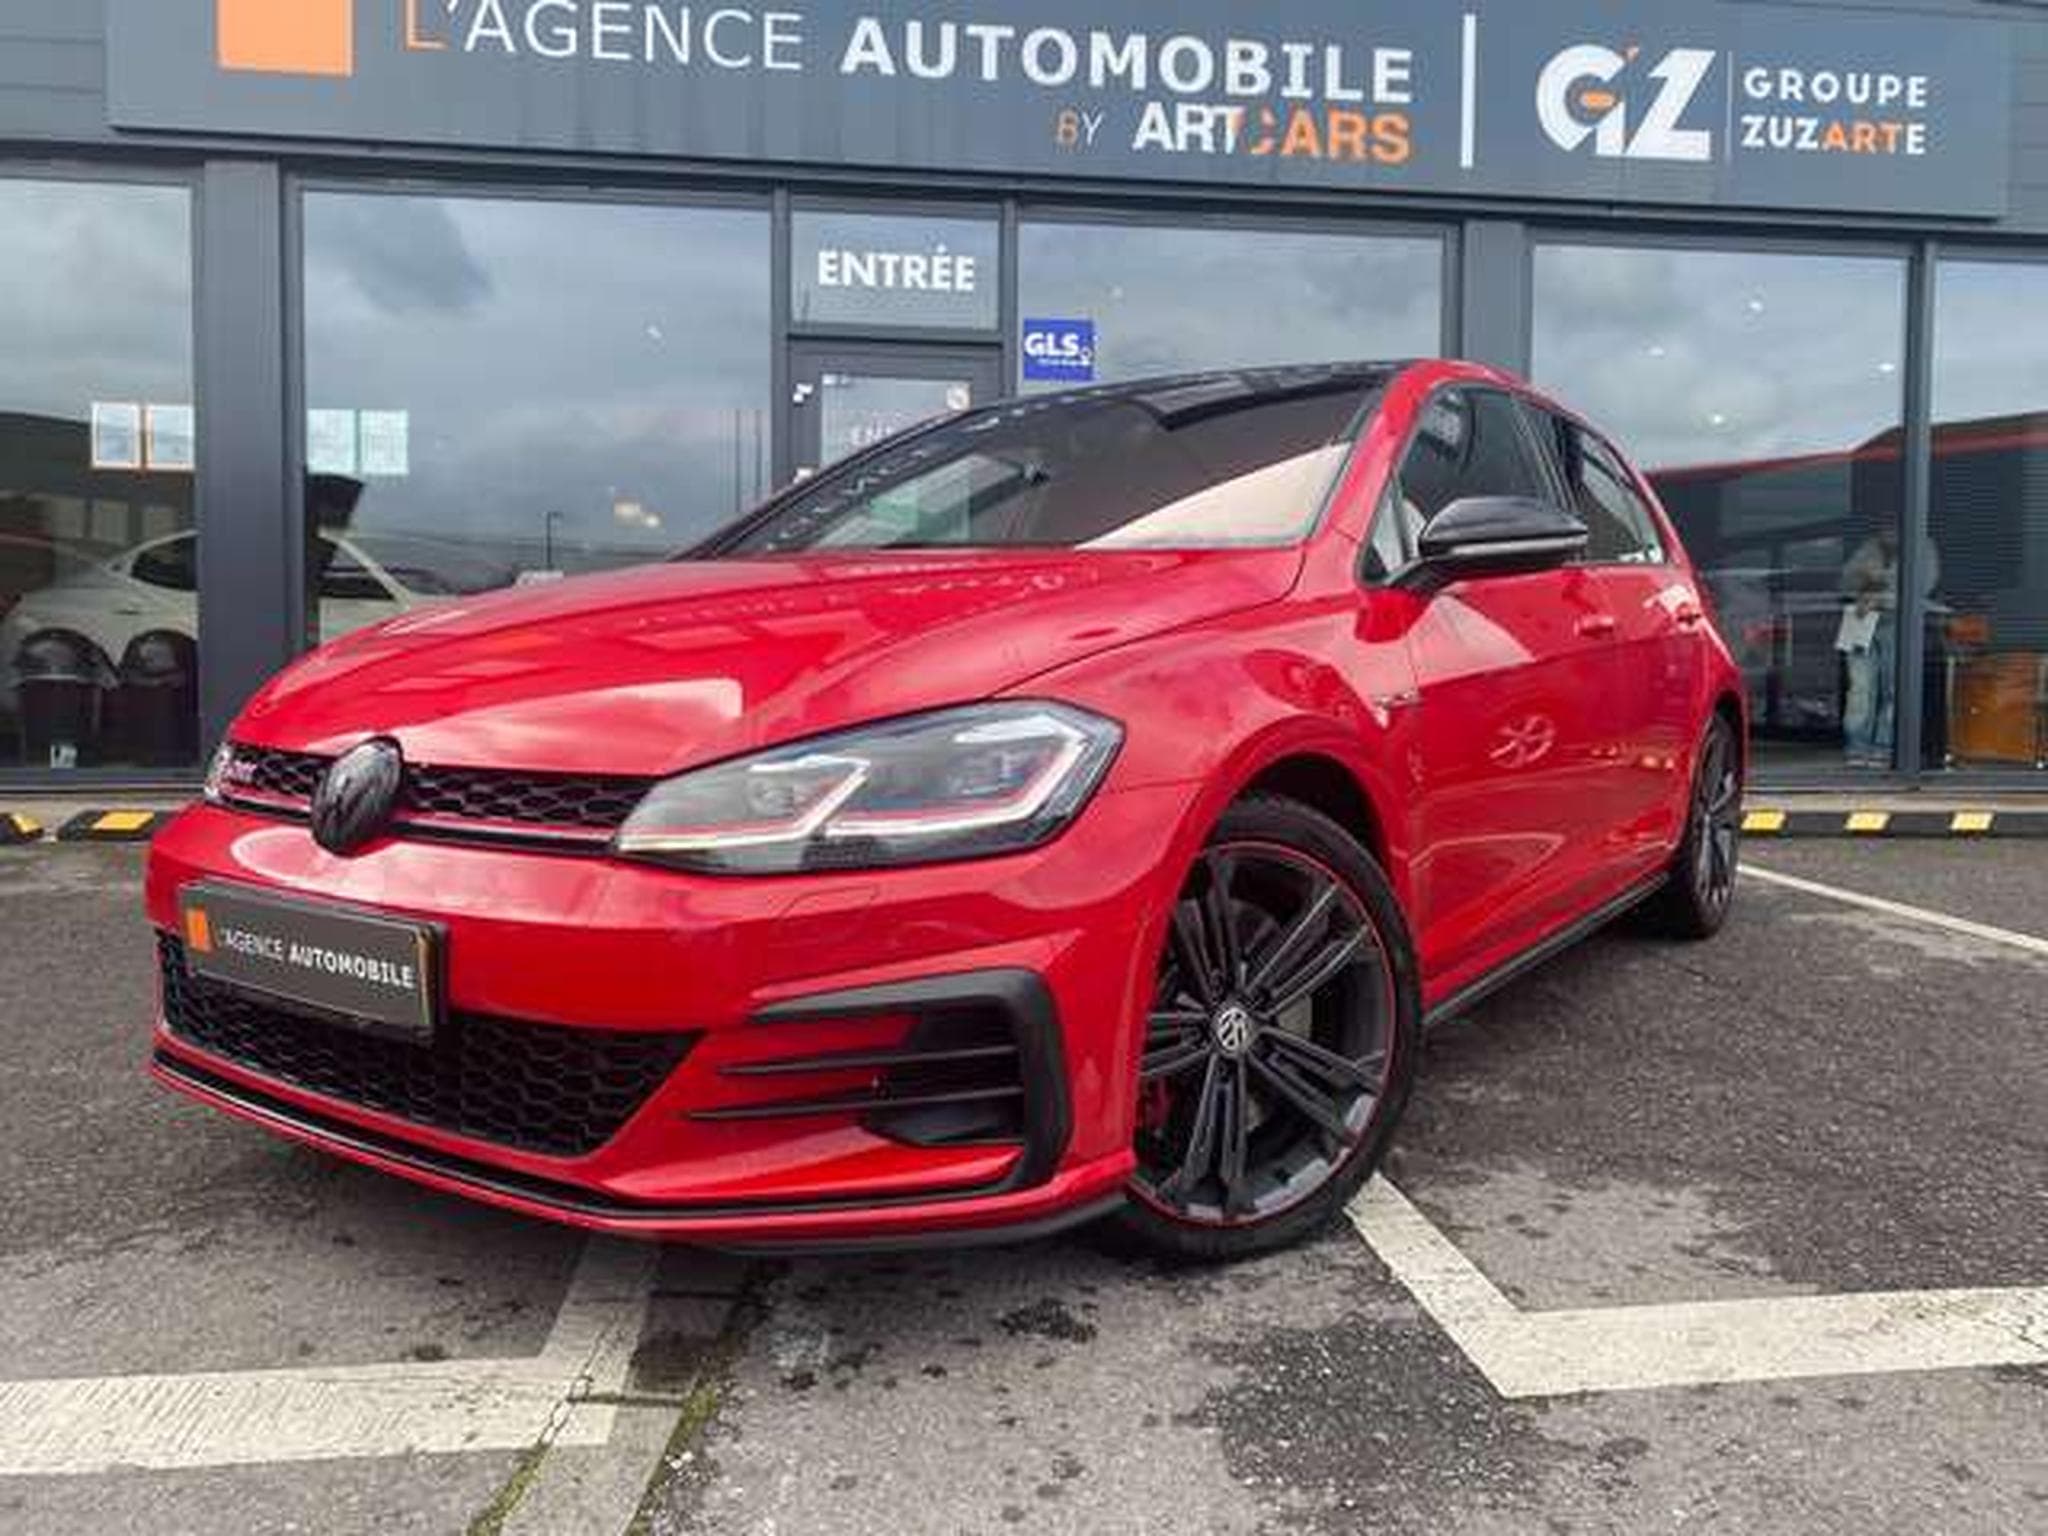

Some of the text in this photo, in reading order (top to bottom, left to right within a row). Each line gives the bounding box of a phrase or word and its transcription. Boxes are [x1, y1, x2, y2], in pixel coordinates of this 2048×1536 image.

[404, 0, 1413, 104] L'AGENCE AUTOMOBILE
[1743, 67, 1929, 108] GROUPE
[1056, 109, 1104, 147] BY
[1741, 115, 1927, 155] ZUZARTE
[818, 243, 976, 292] ENTRÉE
[288, 943, 416, 990] AUTOMOBILE
